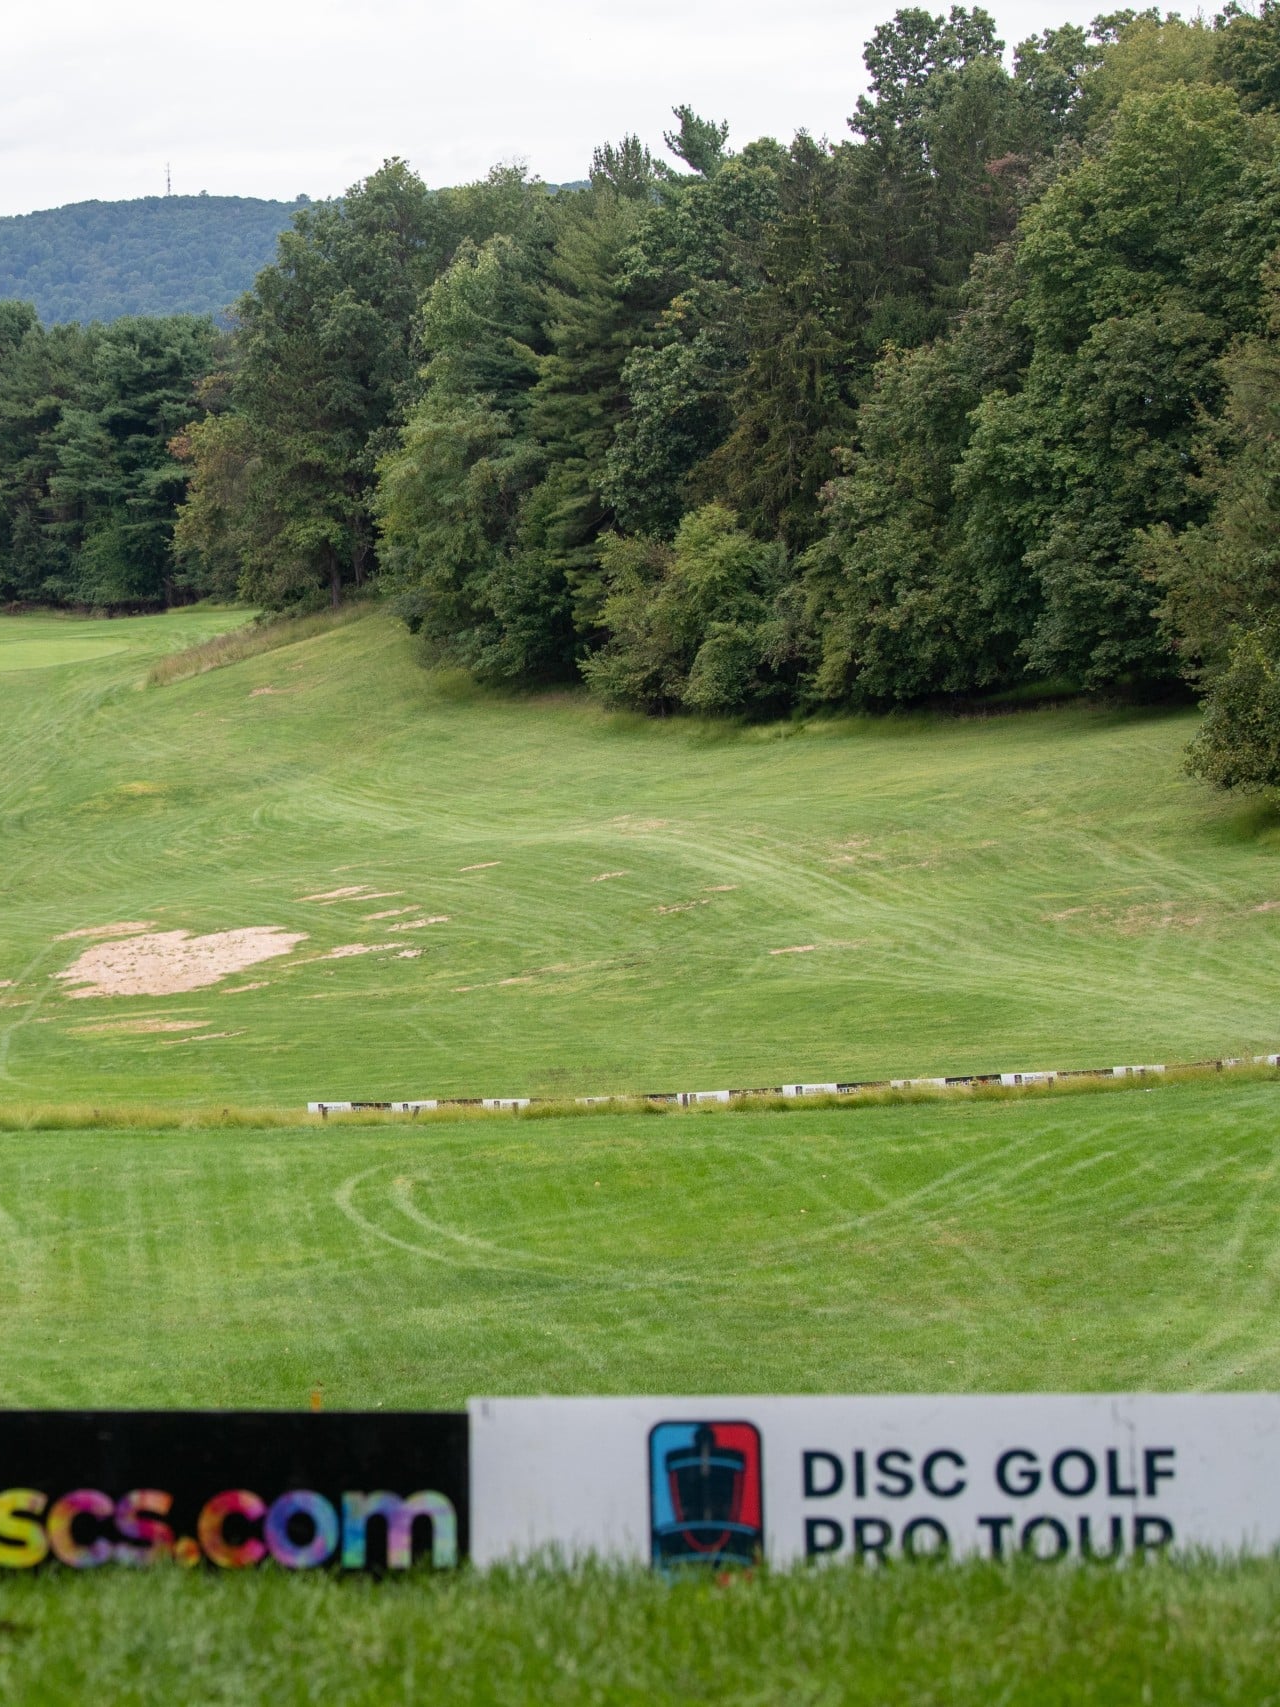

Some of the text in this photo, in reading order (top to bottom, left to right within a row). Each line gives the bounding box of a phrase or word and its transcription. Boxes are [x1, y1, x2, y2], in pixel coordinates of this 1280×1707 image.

[802, 1448, 1175, 1498] DISC GOLF
[804, 1516, 949, 1567] PRO
